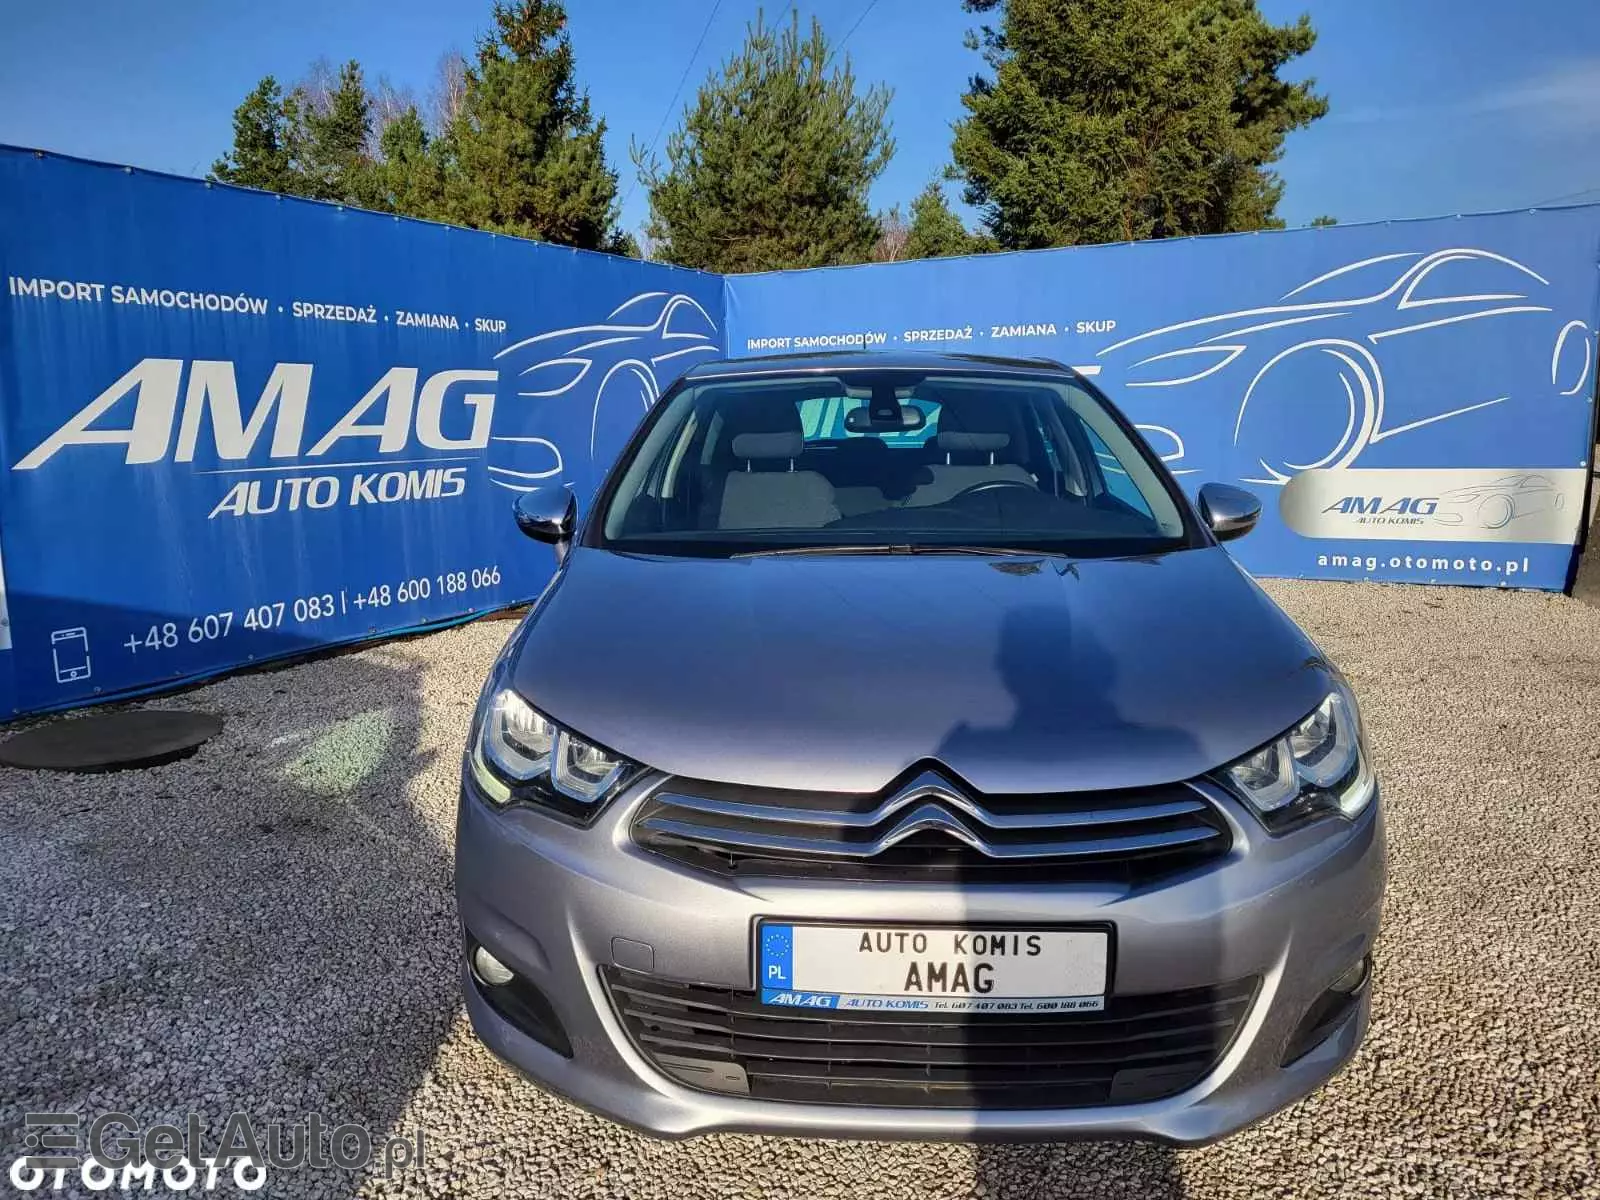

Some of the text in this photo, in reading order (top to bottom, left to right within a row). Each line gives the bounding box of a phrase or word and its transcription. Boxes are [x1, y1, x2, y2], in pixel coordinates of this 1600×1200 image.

[9, 276, 507, 333] IMPORT SAMOCHODÓW SPRZEDAŻ ZAMIANA SKUP
[747, 320, 1116, 350] IMPORT SAMOCHODÓW SPRZEDAŻ ZAMIANA SKUP
[208, 467, 467, 520] AUTO KOMIS
[1317, 554, 1529, 575] amag.otomoto.pl
[123, 565, 501, 654] +48 607 407 083 +48 600 188 066
[859, 932, 1042, 956] AUTO KOMIS
[768, 965, 787, 980] PL
[903, 962, 995, 994] AMAG
[845, 998, 882, 1009] AUTO
[885, 999, 929, 1009] KOMIS
